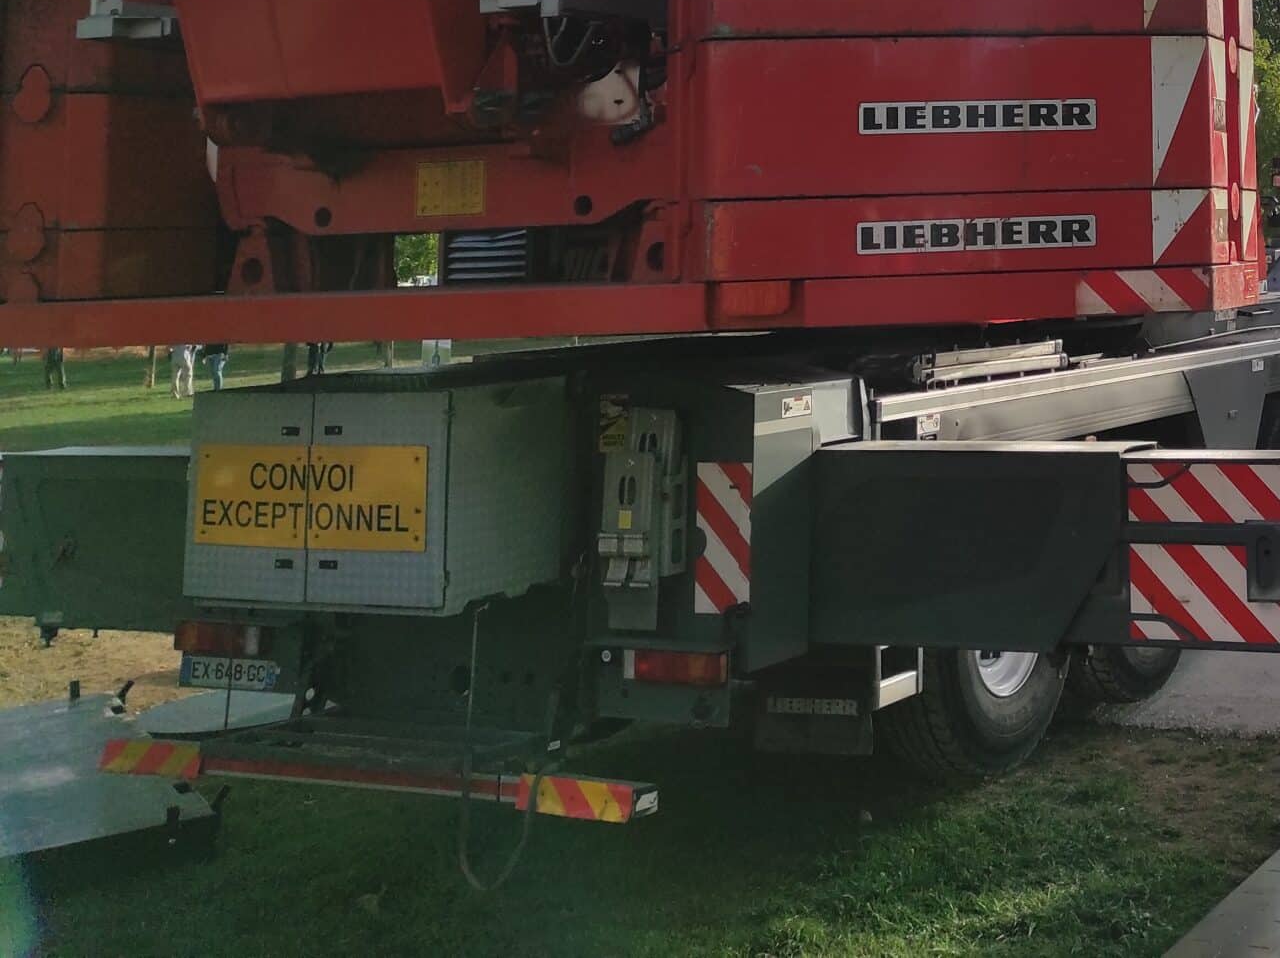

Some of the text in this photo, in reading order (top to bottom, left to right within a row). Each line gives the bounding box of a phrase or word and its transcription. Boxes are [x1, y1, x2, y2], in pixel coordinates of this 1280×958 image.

[862, 103, 1092, 131] LIEBHERR
[861, 220, 1092, 250] LIEBHERR
[250, 462, 354, 492] CONVOI
[202, 499, 409, 532] EXCEPTIONNEL
